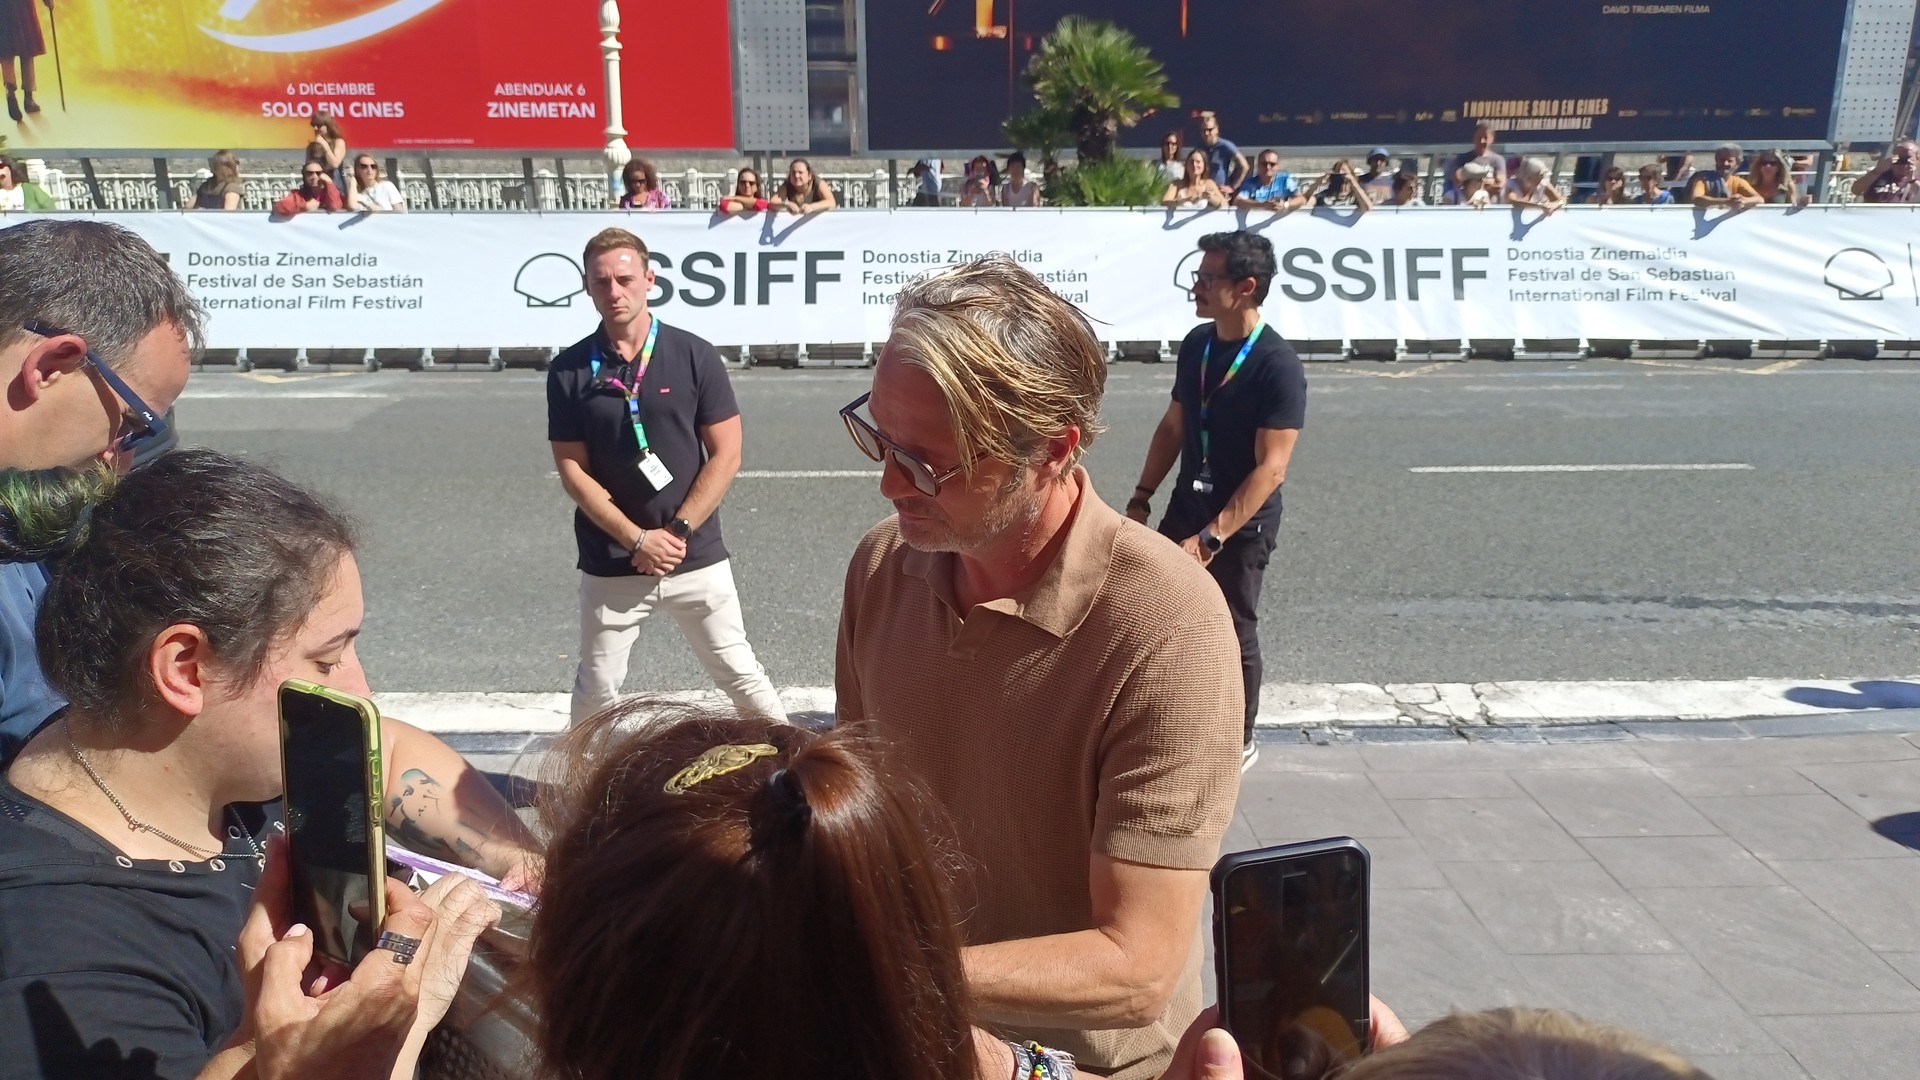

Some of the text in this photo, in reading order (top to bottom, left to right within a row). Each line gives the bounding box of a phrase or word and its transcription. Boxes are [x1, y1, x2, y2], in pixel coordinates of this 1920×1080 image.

[1602, 4, 1710, 14] DAVID TRUEBAREN FILMA
[286, 82, 375, 96] 6 DICIEMBRE
[494, 82, 586, 96] ABENDUAK 6
[261, 101, 405, 118] SOLO EN CINES
[486, 101, 596, 118] ZINEMETAN
[1463, 101, 1469, 118] 1
[1470, 100, 1531, 118] NOVIEMBRE
[1532, 100, 1559, 117] SOLO
[1561, 99, 1576, 116] EN
[1577, 98, 1609, 116] CINES
[188, 252, 270, 267] Donostia
[276, 252, 379, 268] Zinemaldia
[862, 250, 941, 265] Donostia
[1507, 247, 1688, 261] Donostia Zinemaldia
[187, 273, 424, 289] Festival de San Sebastián
[1280, 247, 1490, 302] SSIFF
[1508, 267, 1575, 282] Festival
[1581, 267, 1603, 281] de
[1509, 288, 1620, 302] International
[1626, 287, 1664, 301] Film
[197, 295, 423, 310] ternational Film Festival
